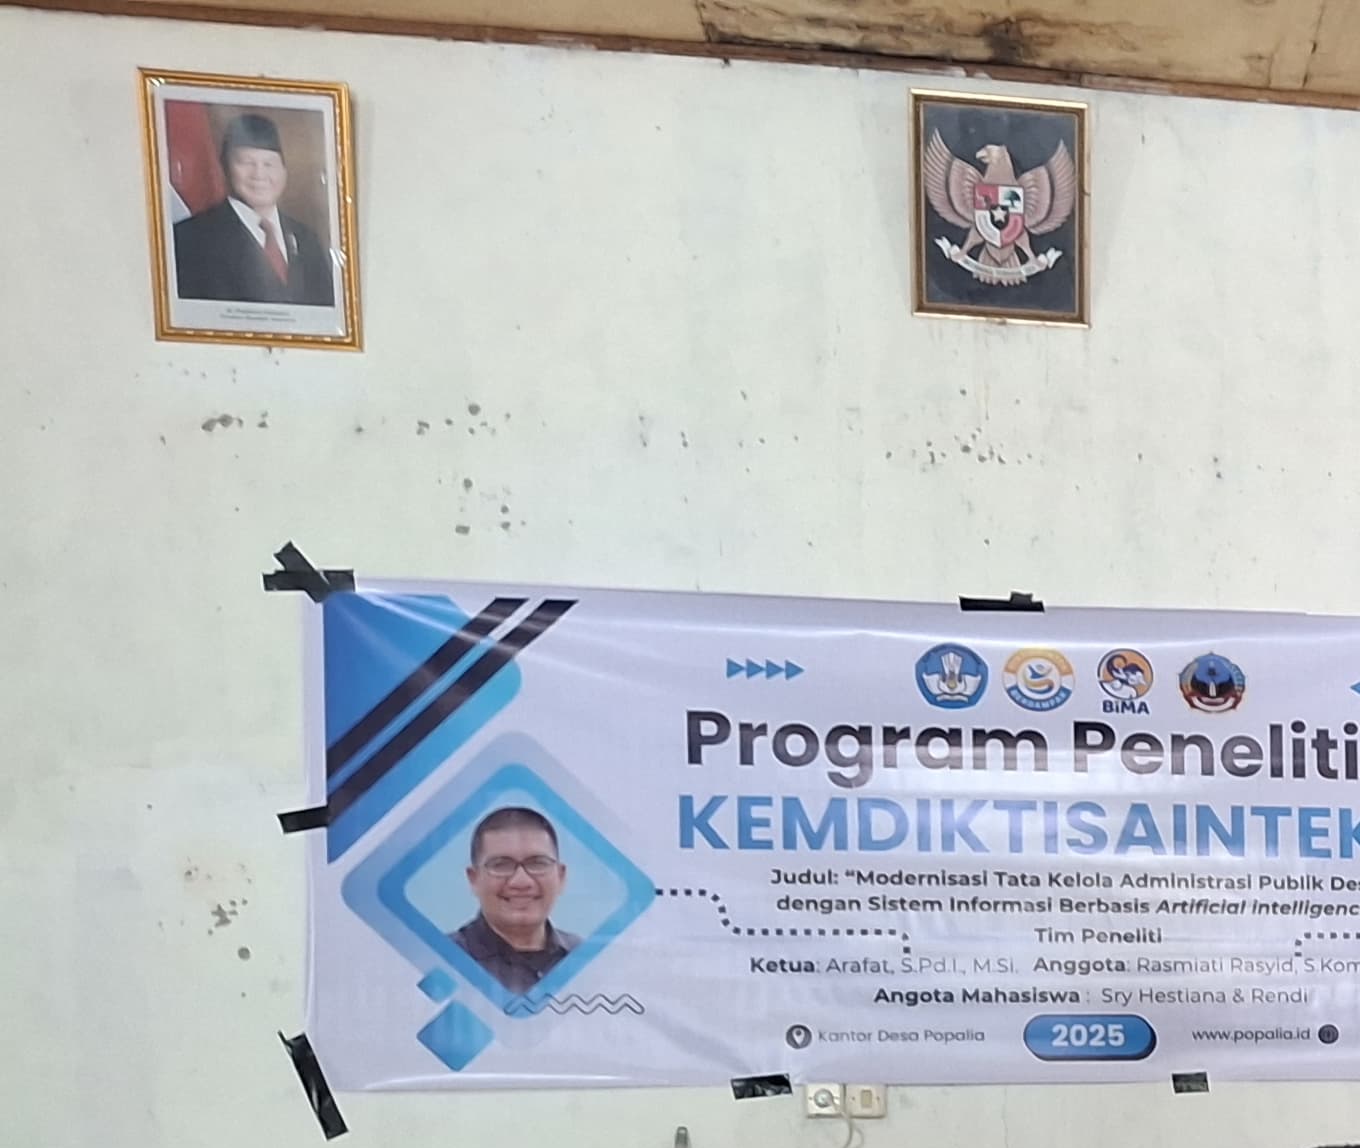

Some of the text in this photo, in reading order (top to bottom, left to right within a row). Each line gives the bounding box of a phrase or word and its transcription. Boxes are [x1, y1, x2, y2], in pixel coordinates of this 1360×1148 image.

[686, 710, 1049, 789] Program
[771, 868, 838, 886] Judul:
[994, 870, 1041, 887] Tata
[1048, 872, 1113, 889] Kelola
[1120, 873, 1252, 890] Administrasi
[1258, 874, 1324, 891] Publik
[776, 896, 861, 914] dengan
[868, 896, 943, 912] Sistem
[950, 897, 1052, 913] Informasi
[1059, 897, 1151, 914] Berbasis
[1155, 899, 1246, 915] Artificial
[1034, 927, 1163, 944] Tim Peneliti
[750, 957, 820, 974] Ketua:
[825, 957, 895, 975] Arafat,
[973, 957, 1019, 974] M.Si.
[1033, 957, 1131, 976] Anggota:
[1137, 956, 1223, 973] Rasmiati
[1230, 956, 1300, 977] Rasyid,
[874, 988, 955, 1006] Angota
[962, 987, 1081, 1004] Mahasiswa
[1101, 988, 1133, 1006] Sry
[1139, 988, 1227, 1004] Hestiana
[1232, 988, 1246, 1004] &
[1252, 988, 1308, 1004] Rendi
[818, 1029, 985, 1046] Kantor Desa Popalia
[1051, 1023, 1125, 1047] 2025
[1191, 1027, 1311, 1044] www.popalia.id
